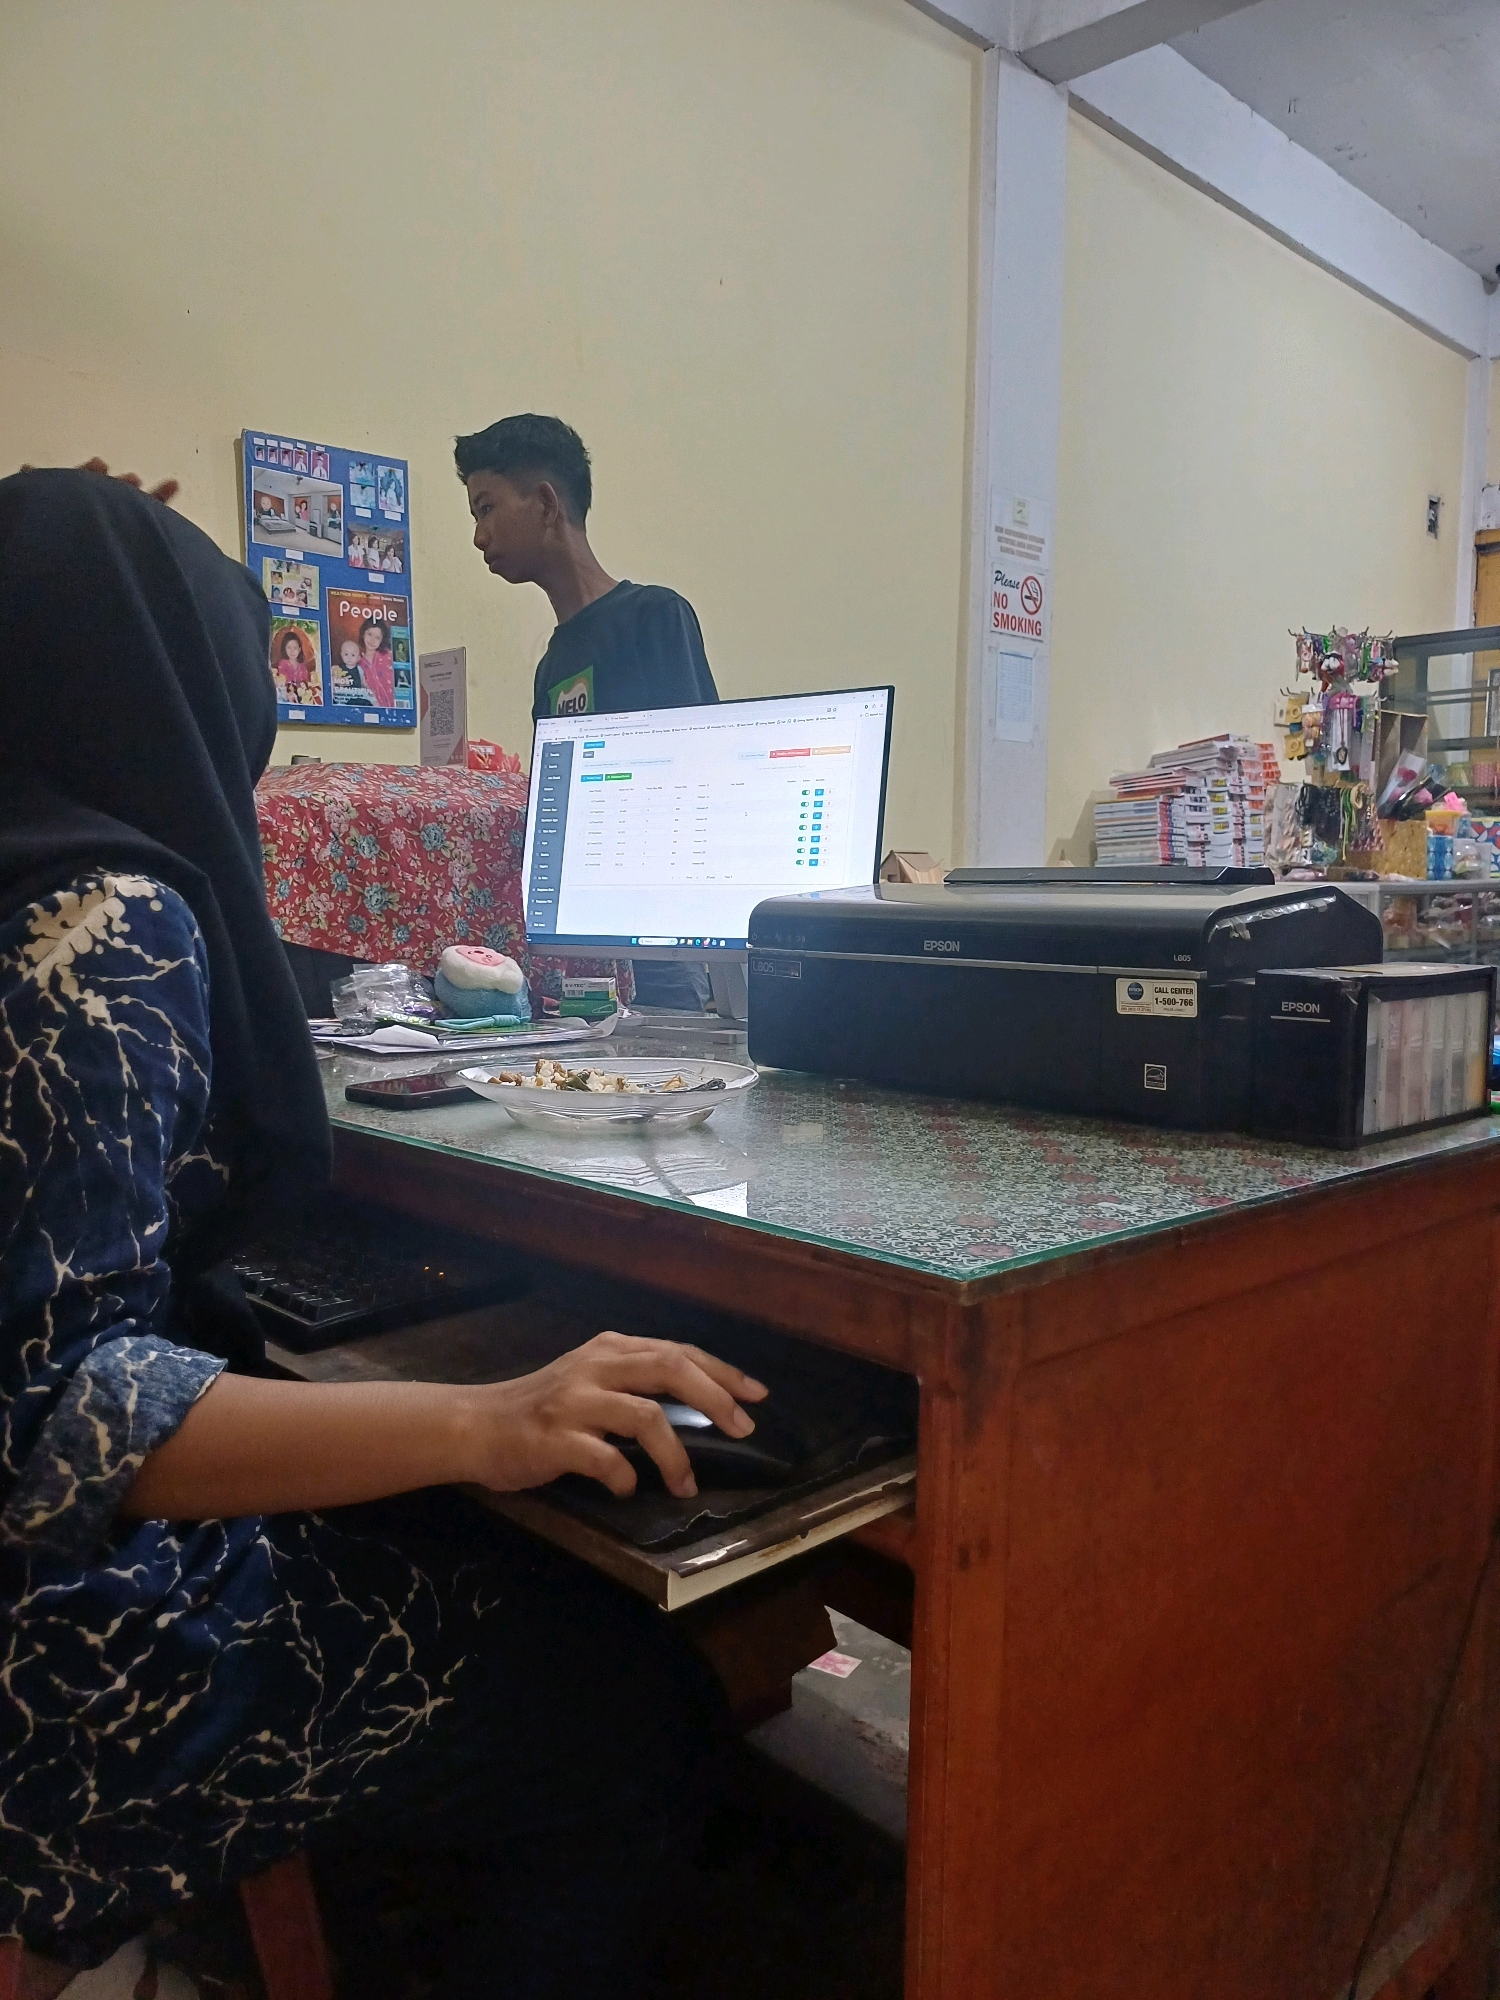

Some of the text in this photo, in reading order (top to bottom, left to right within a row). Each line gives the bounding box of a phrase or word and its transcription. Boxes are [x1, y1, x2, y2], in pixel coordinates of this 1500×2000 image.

[994, 570, 1020, 590] Please
[994, 591, 1008, 610] NO
[340, 600, 398, 625] People
[993, 611, 1042, 637] SMOKING
[923, 940, 960, 952] EPSON
[1154, 986, 1194, 995] CALL CENTER
[1154, 997, 1194, 1007] 1-500-766
[1281, 1001, 1320, 1014] EPSON
